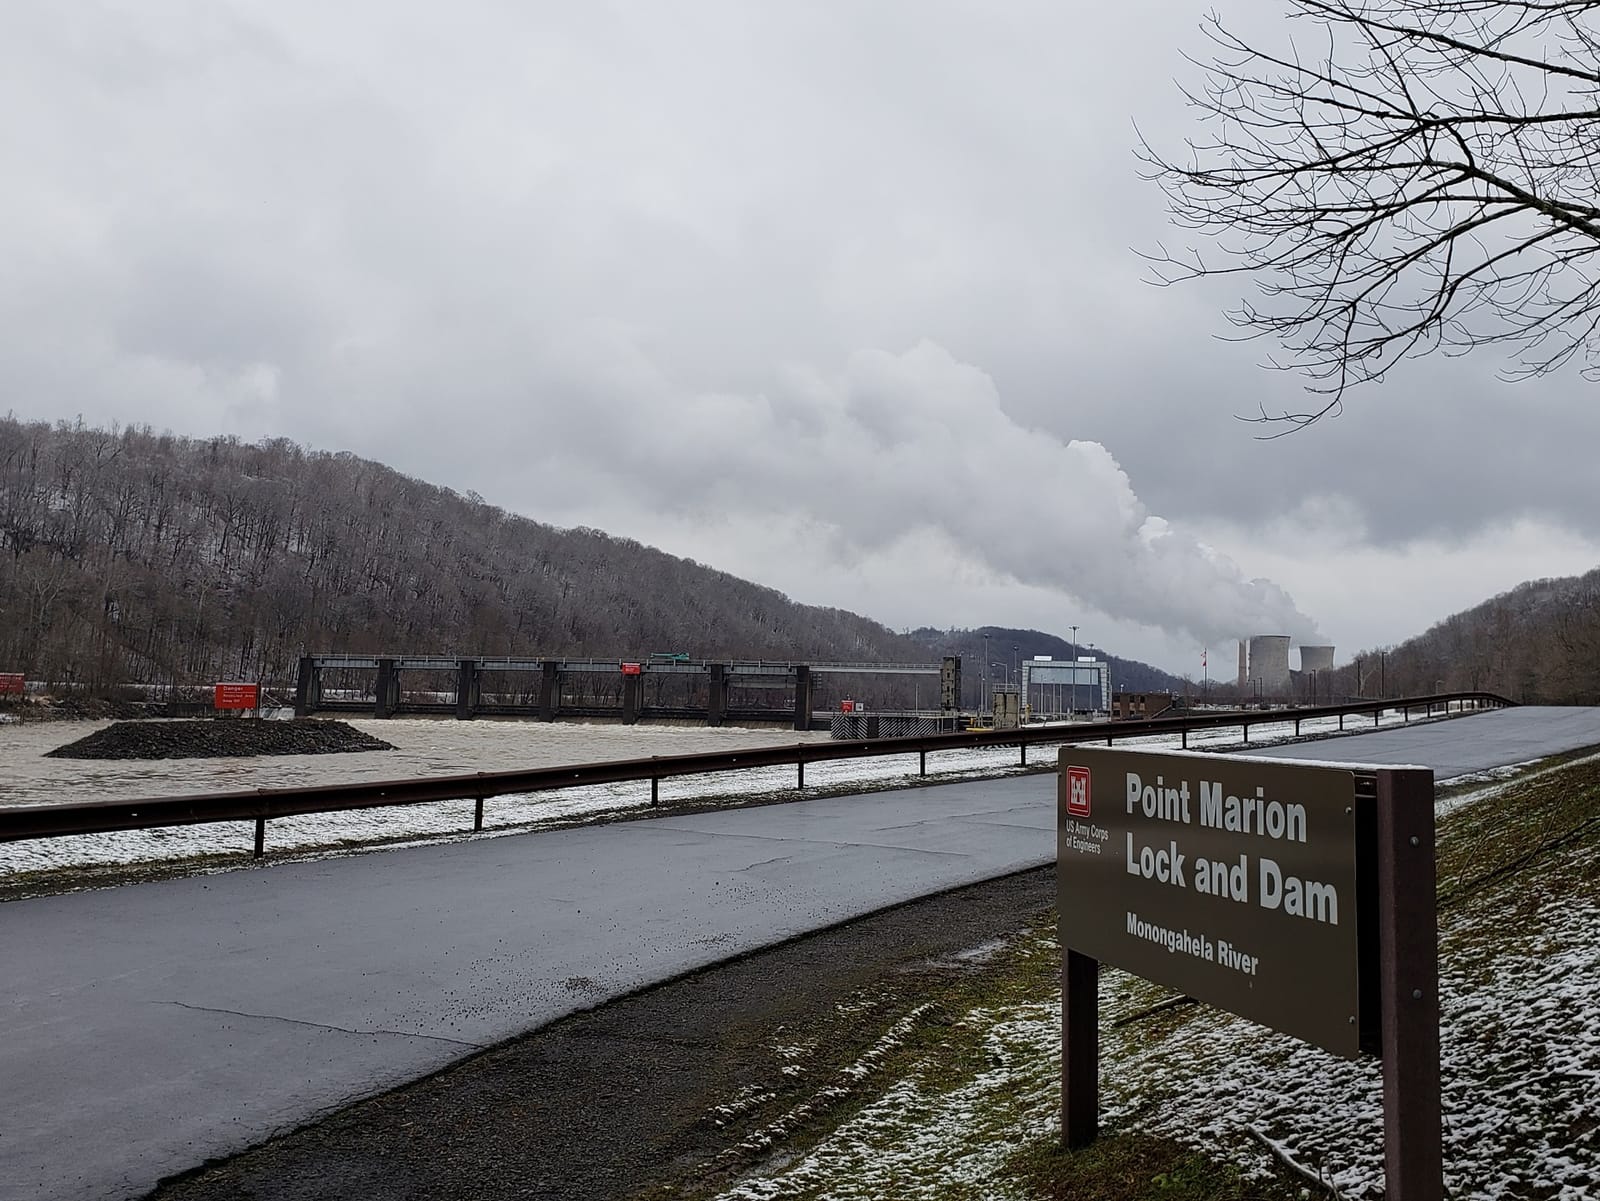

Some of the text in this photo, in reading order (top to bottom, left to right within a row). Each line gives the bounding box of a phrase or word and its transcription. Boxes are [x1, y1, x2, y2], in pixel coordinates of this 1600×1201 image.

[1066, 819, 1109, 842] US Army Corps
[1126, 772, 1307, 843] Point Marion
[1066, 835, 1101, 854] of Engineers
[1126, 832, 1338, 926] Lock and Dam
[1127, 911, 1258, 976] Monongahela River
